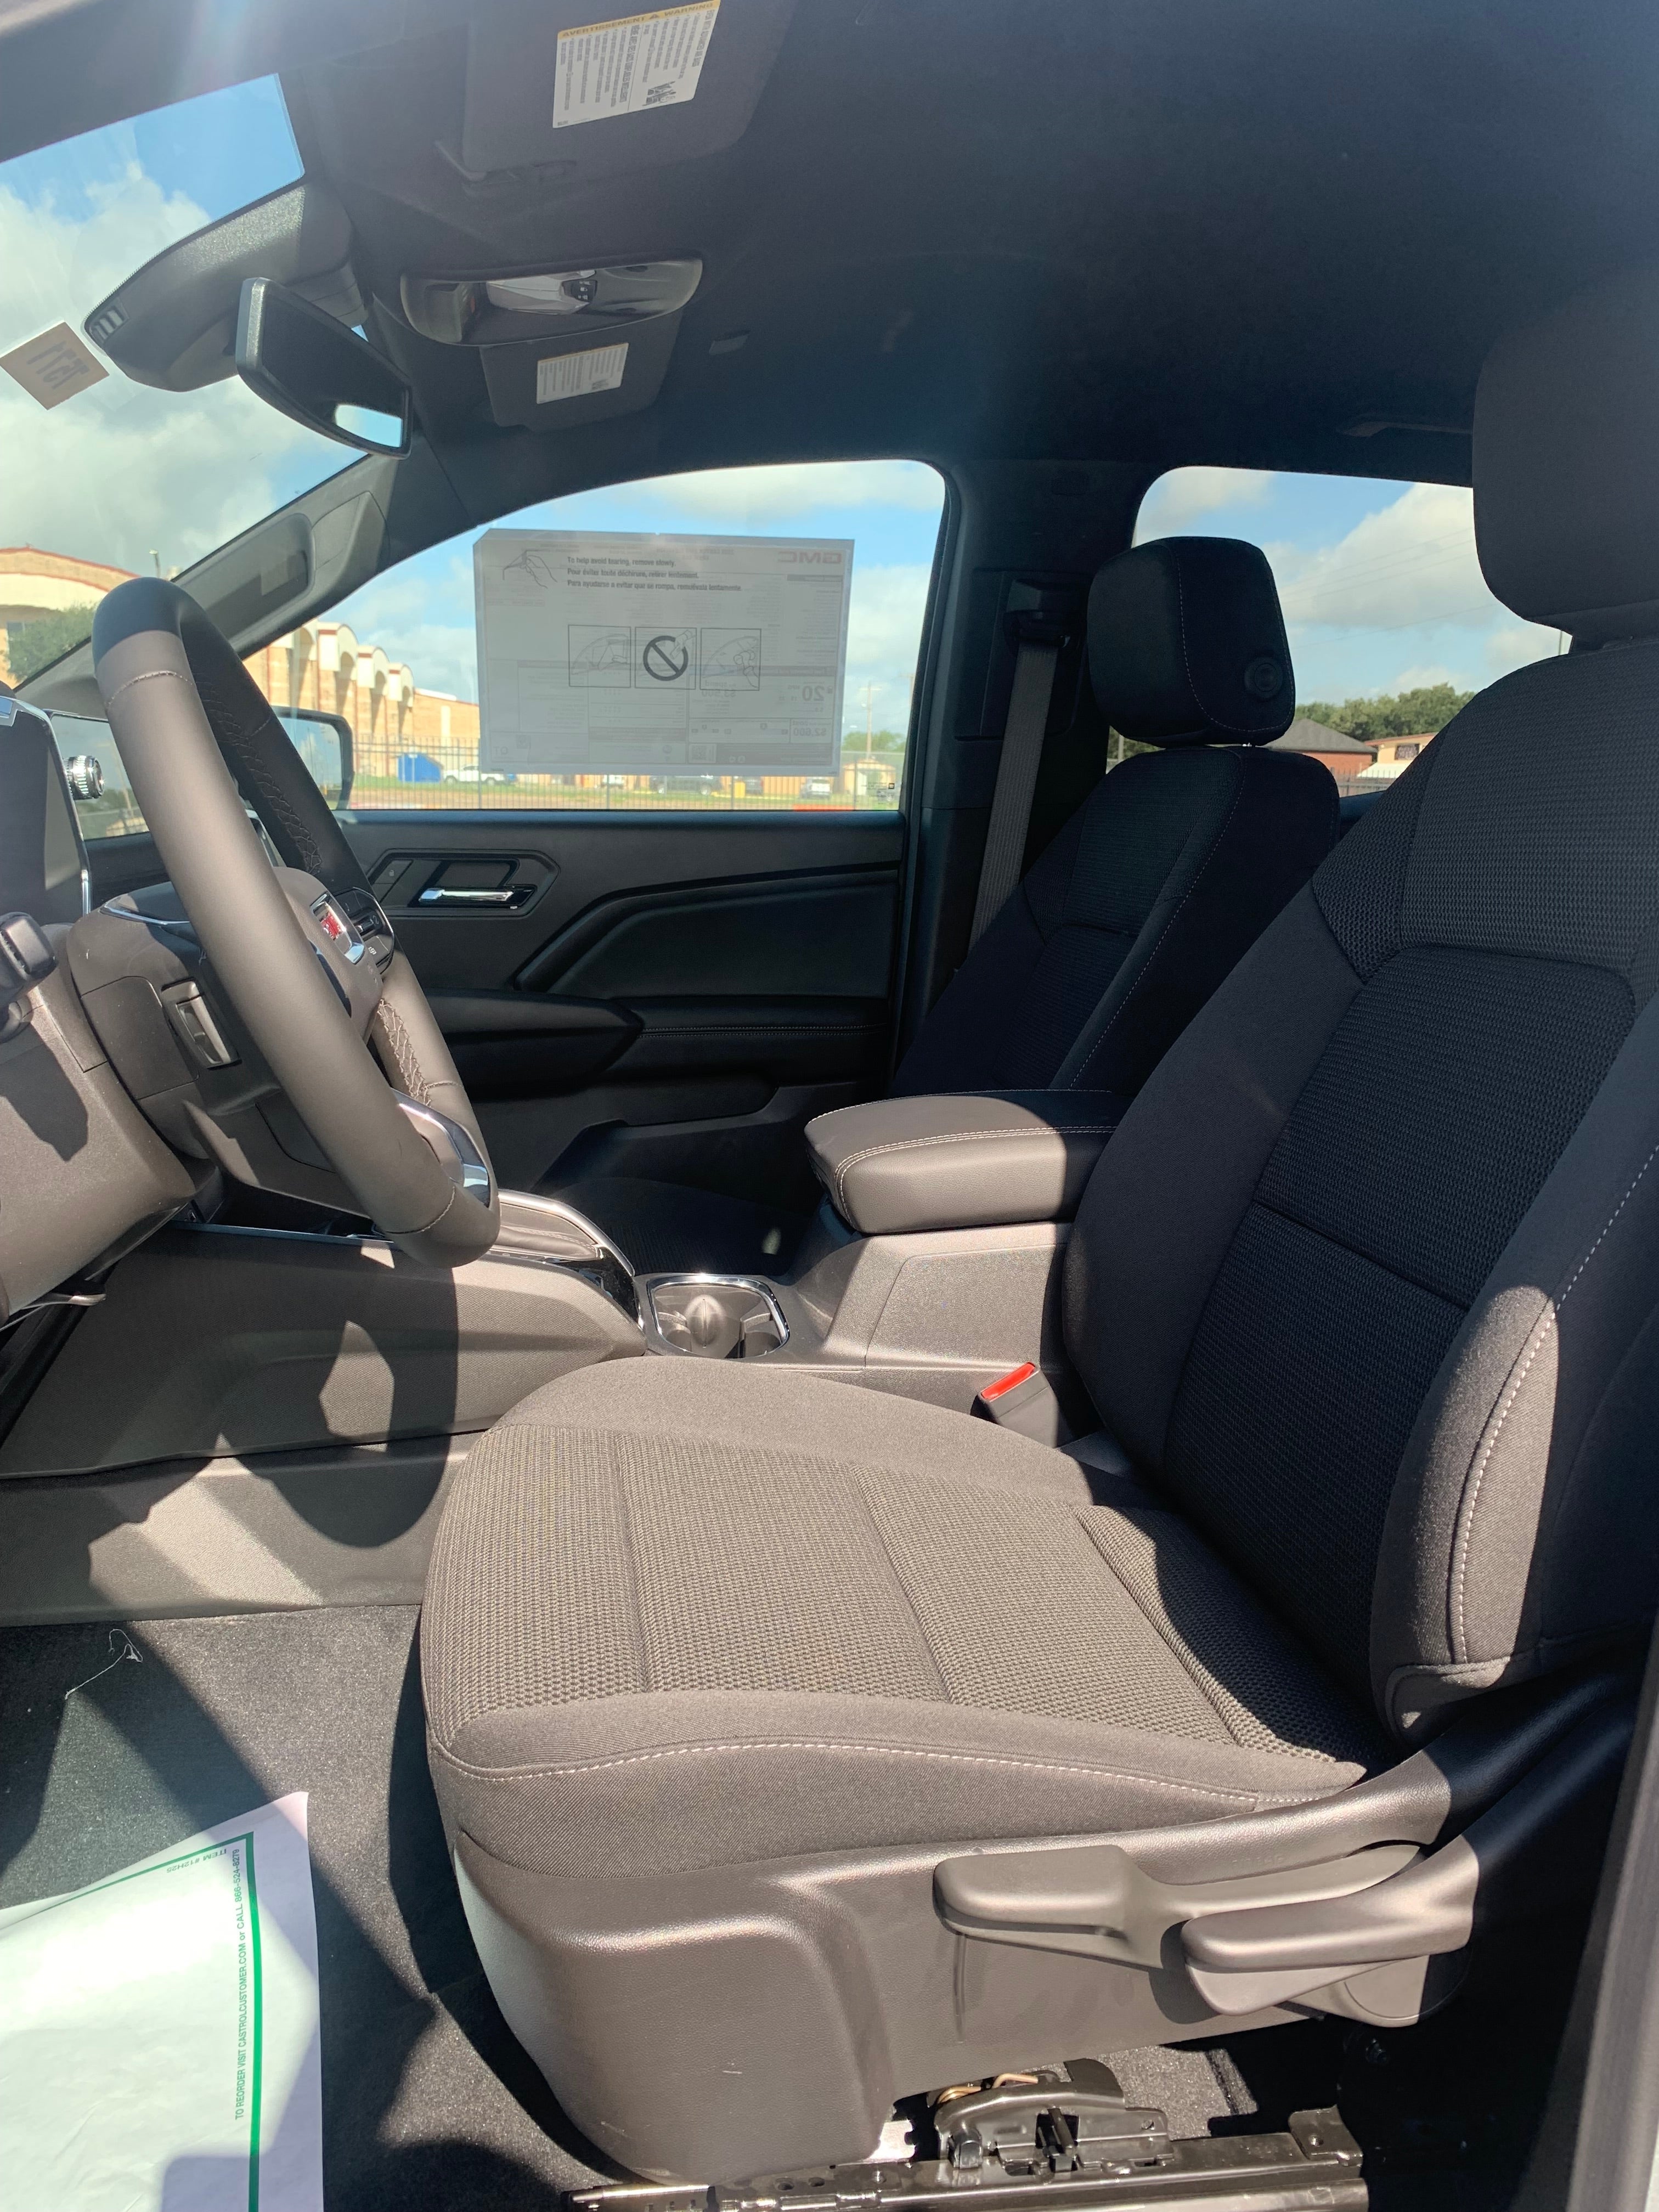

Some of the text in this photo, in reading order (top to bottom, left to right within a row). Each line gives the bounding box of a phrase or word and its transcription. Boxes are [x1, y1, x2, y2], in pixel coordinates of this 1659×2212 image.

[664, 3, 715, 16] WARNING
[562, 16, 646, 37] AVERTISSEMENT
[608, 558, 630, 566] tearing,
[656, 559, 676, 567] slowly.
[166, 1849, 227, 1874] ITEM #12H25
[232, 1849, 247, 2120] TO REORDER VISIT CASTROLCUSTOMER.COM or CALL 866-524-8279
